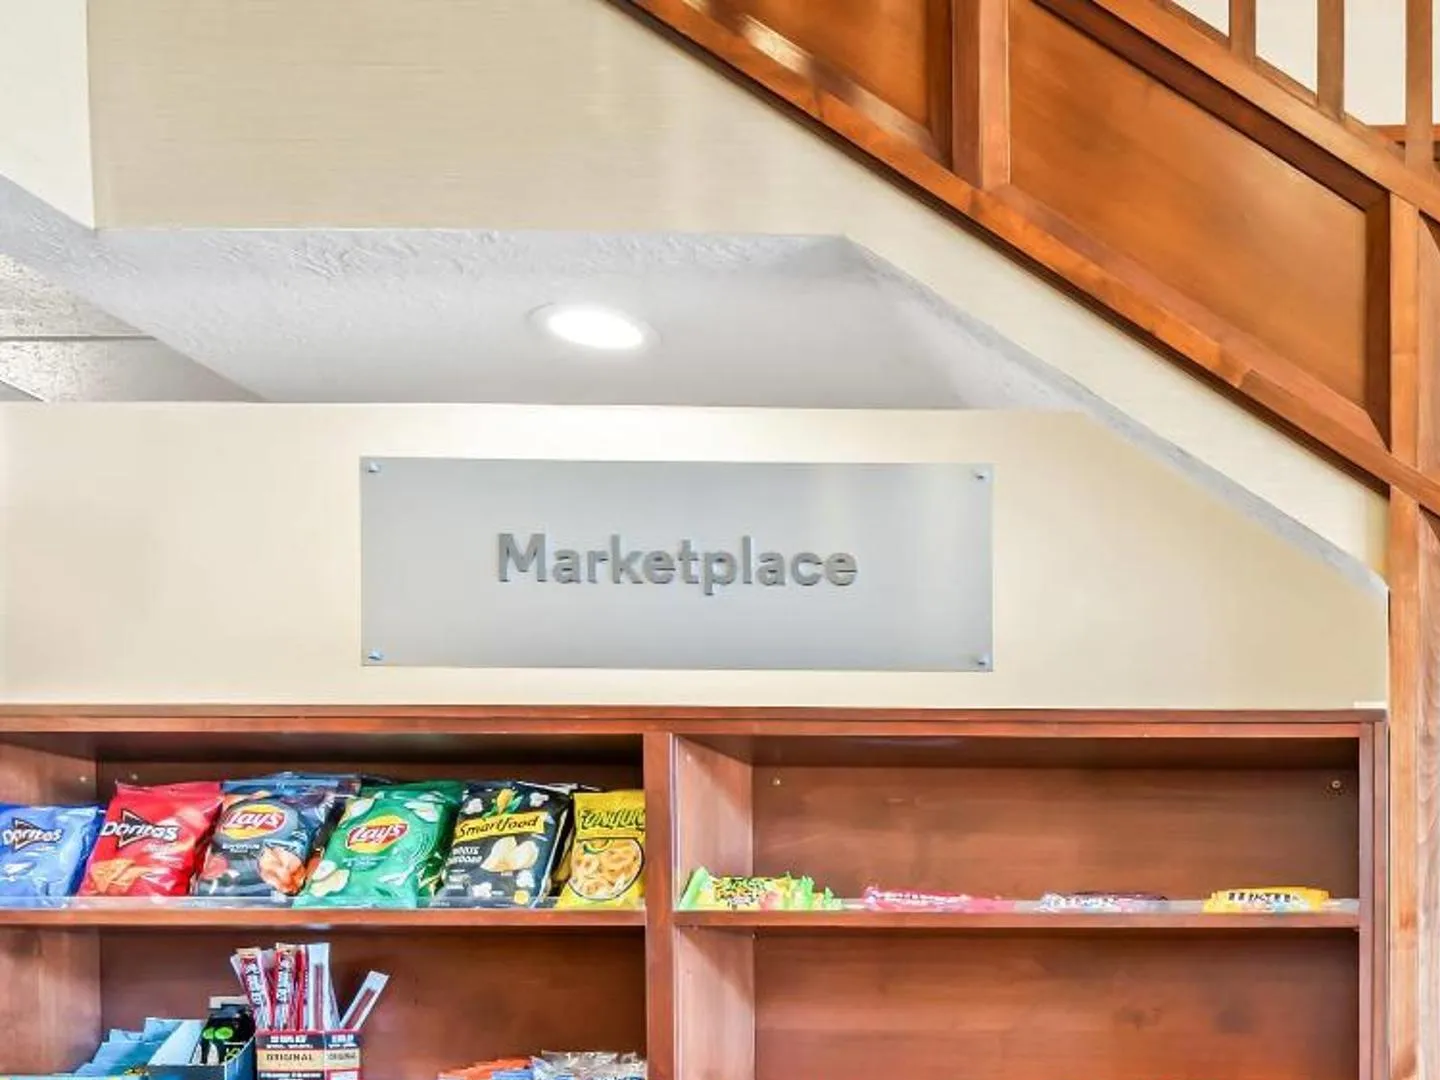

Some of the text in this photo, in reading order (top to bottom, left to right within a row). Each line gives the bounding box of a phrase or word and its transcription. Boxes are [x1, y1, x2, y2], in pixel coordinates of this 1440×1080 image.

[498, 533, 857, 595] Marketplace
[2, 828, 63, 846] Doritos
[101, 820, 179, 842] Doritos
[460, 816, 540, 837] Smartfood
